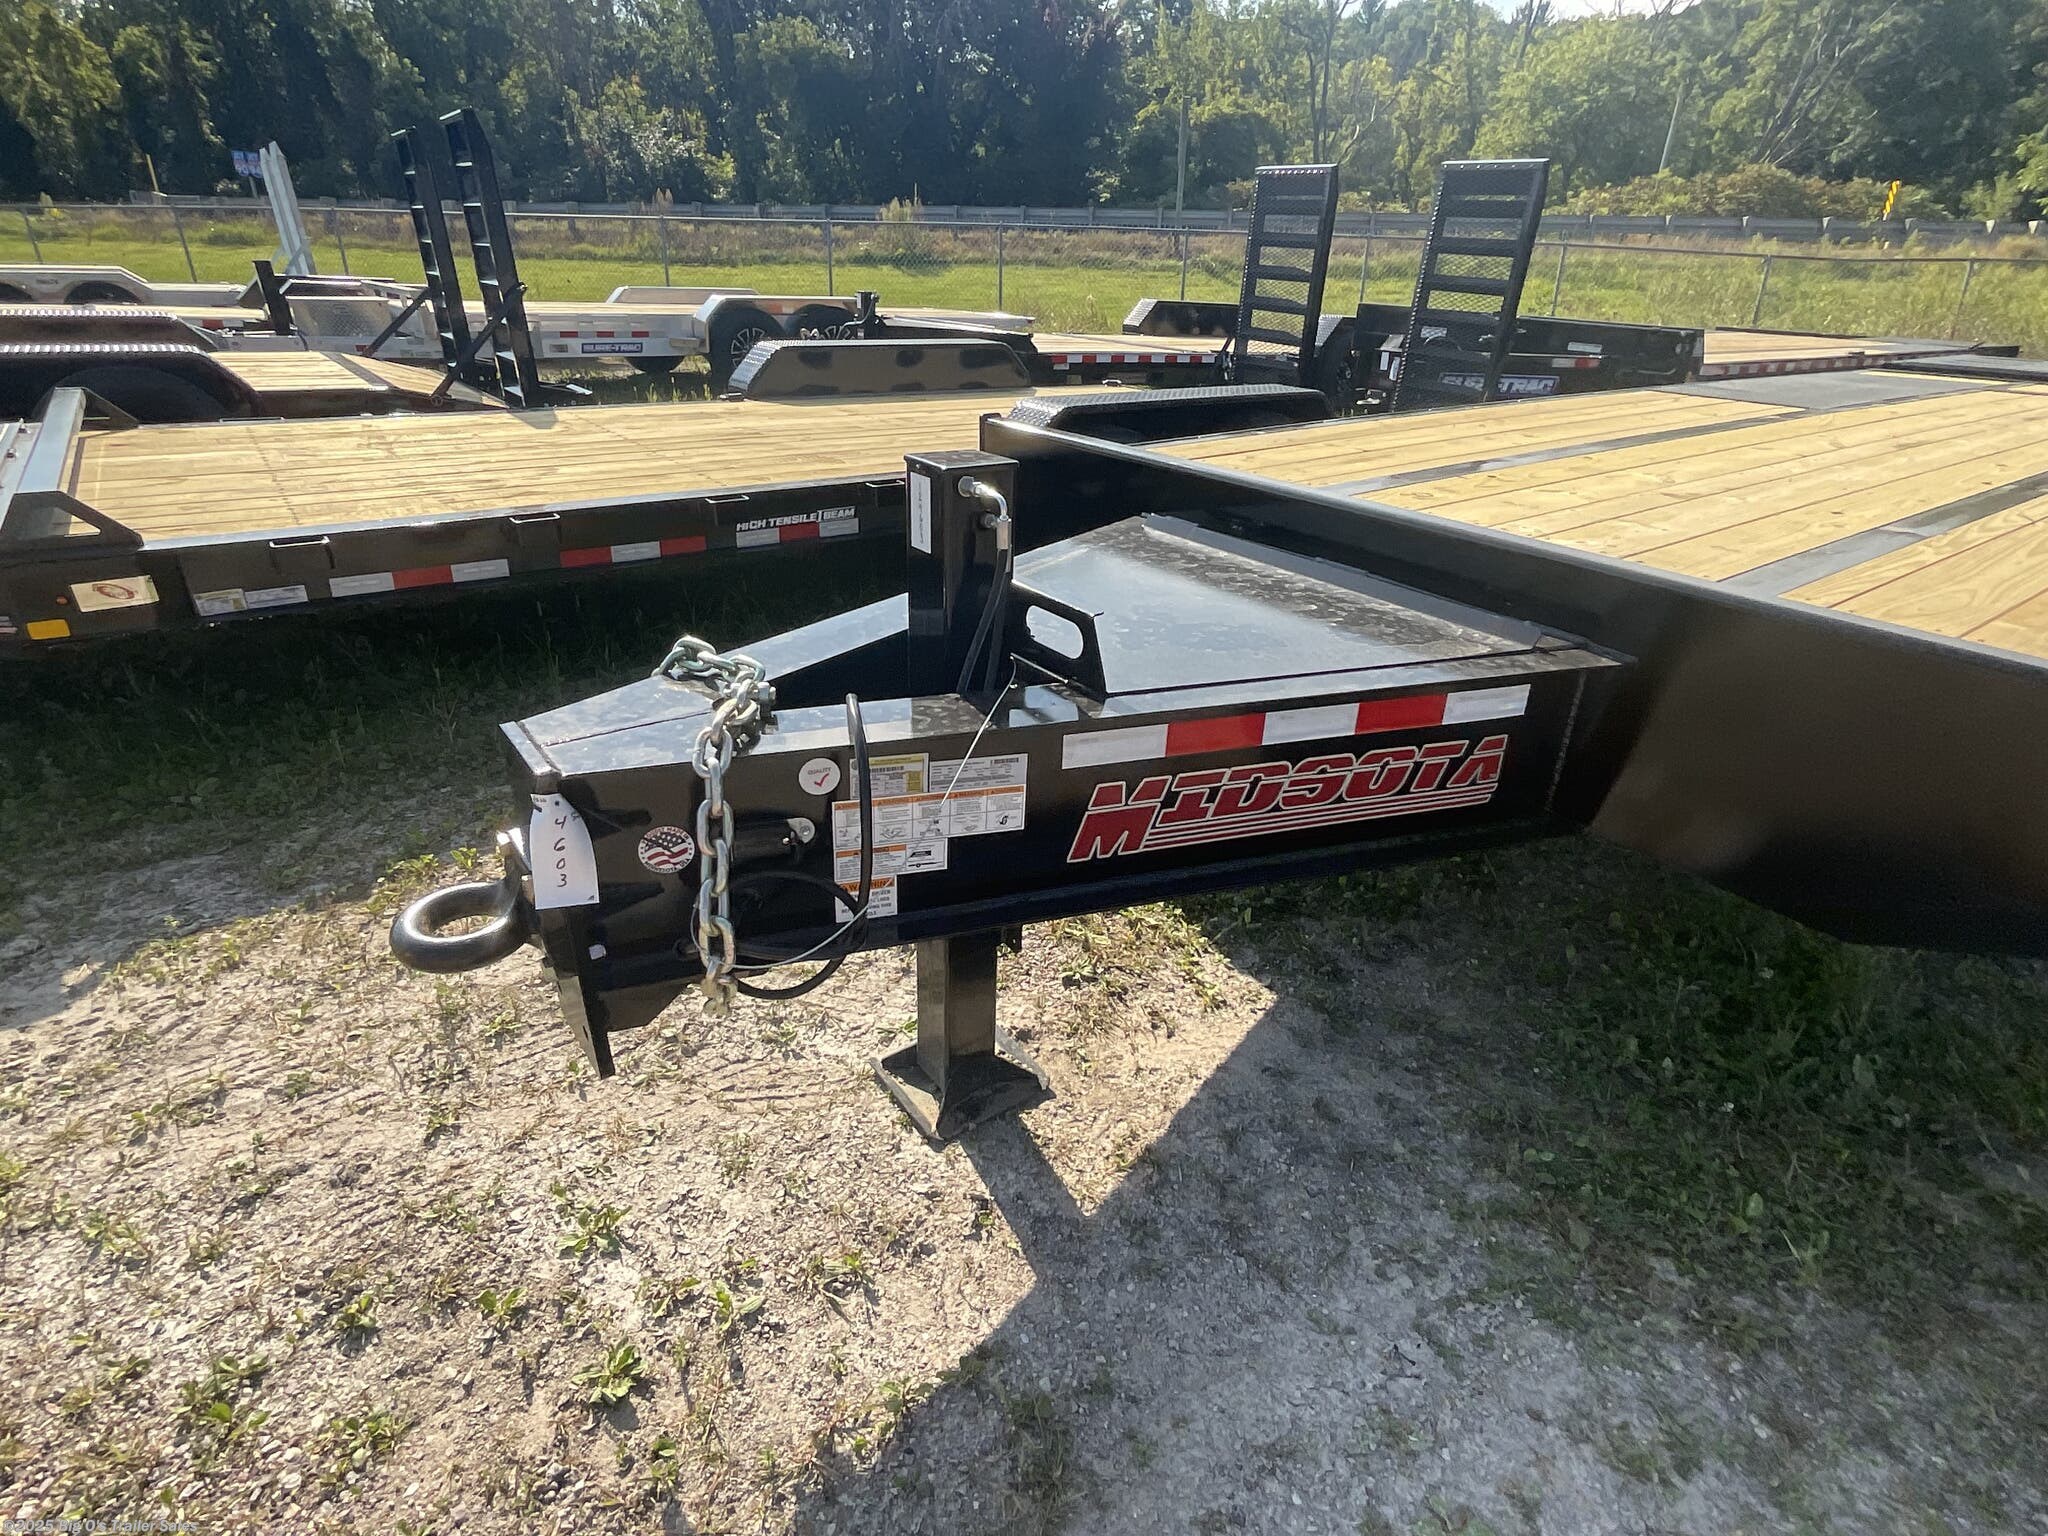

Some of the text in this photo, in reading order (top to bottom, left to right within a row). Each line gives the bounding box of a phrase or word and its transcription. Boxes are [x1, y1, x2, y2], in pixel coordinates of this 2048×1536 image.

[736, 518, 766, 532] HIGH
[766, 512, 817, 527] TENSILE
[823, 507, 855, 520] BEAM
[1067, 734, 1509, 864] MIDSOTA
[848, 878, 893, 892] WNING
